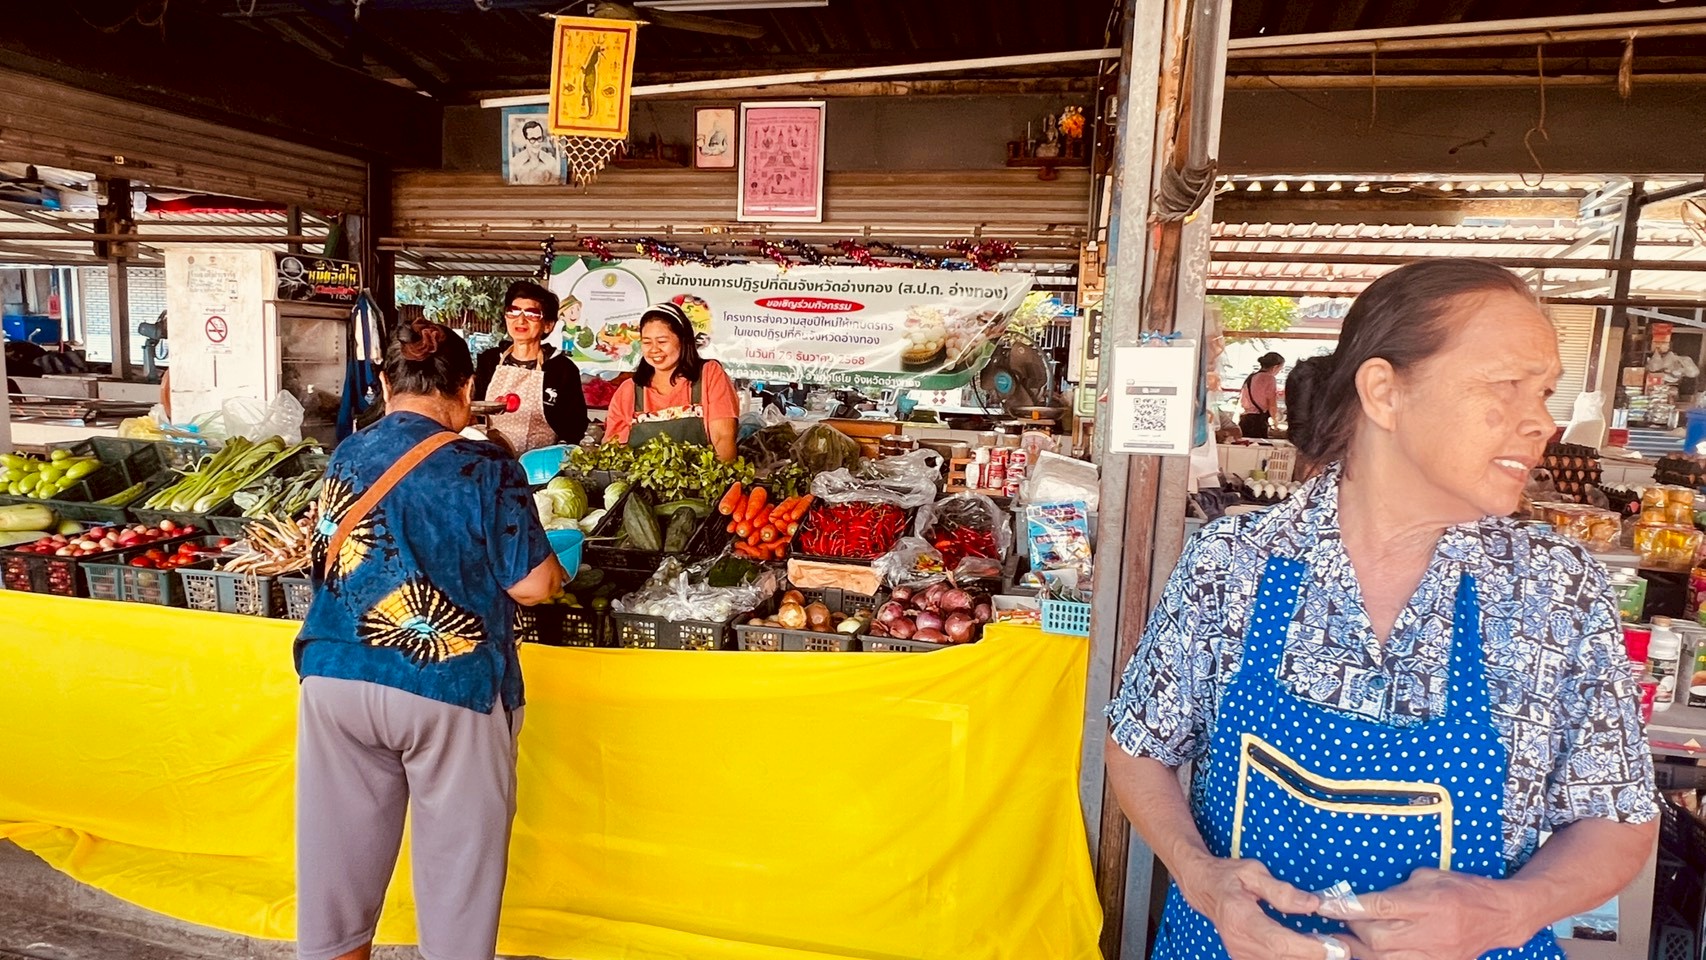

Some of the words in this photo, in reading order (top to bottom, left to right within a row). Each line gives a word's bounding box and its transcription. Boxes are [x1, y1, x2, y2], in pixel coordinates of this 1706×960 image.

[656, 273, 893, 294] สำนักงานการปฏิรูปที่ดินจังหวัดอ่างทอง
[898, 281, 944, 296] (ส.ป.ก.
[949, 281, 1009, 300] อ่างทอง)
[766, 299, 852, 312] ขอเชิญร่วมกิจกรรม
[734, 326, 880, 345] ในเขตปฏิรูปที่ดินจังหวัดอ่างทอง
[745, 347, 775, 360] ในวันที่
[839, 354, 865, 365] 2568
[854, 373, 921, 387] จังหวัดอ่างทอง
